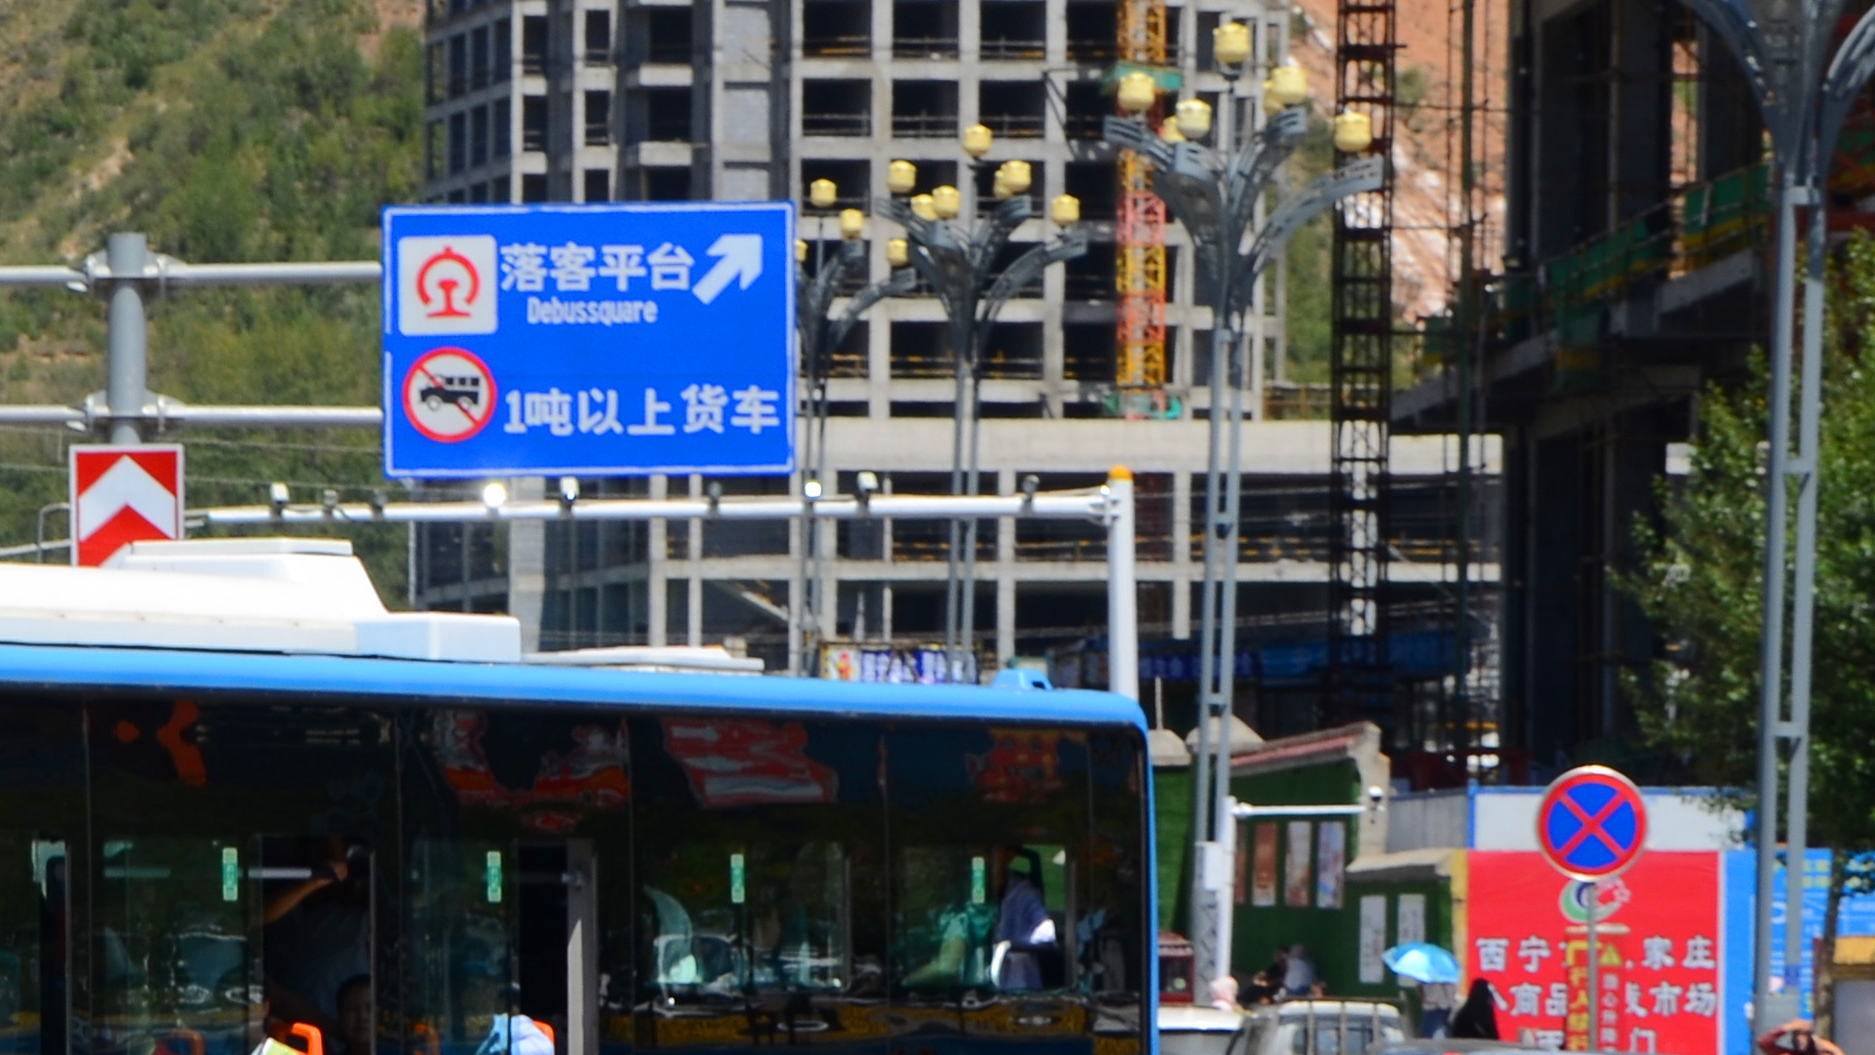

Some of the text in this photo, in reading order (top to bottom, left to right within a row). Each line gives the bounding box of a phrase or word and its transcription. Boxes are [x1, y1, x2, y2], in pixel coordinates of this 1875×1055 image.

[499, 243, 696, 293] 落客平台
[526, 296, 659, 326] Debussquare
[504, 384, 781, 437] 1吨以上货车
